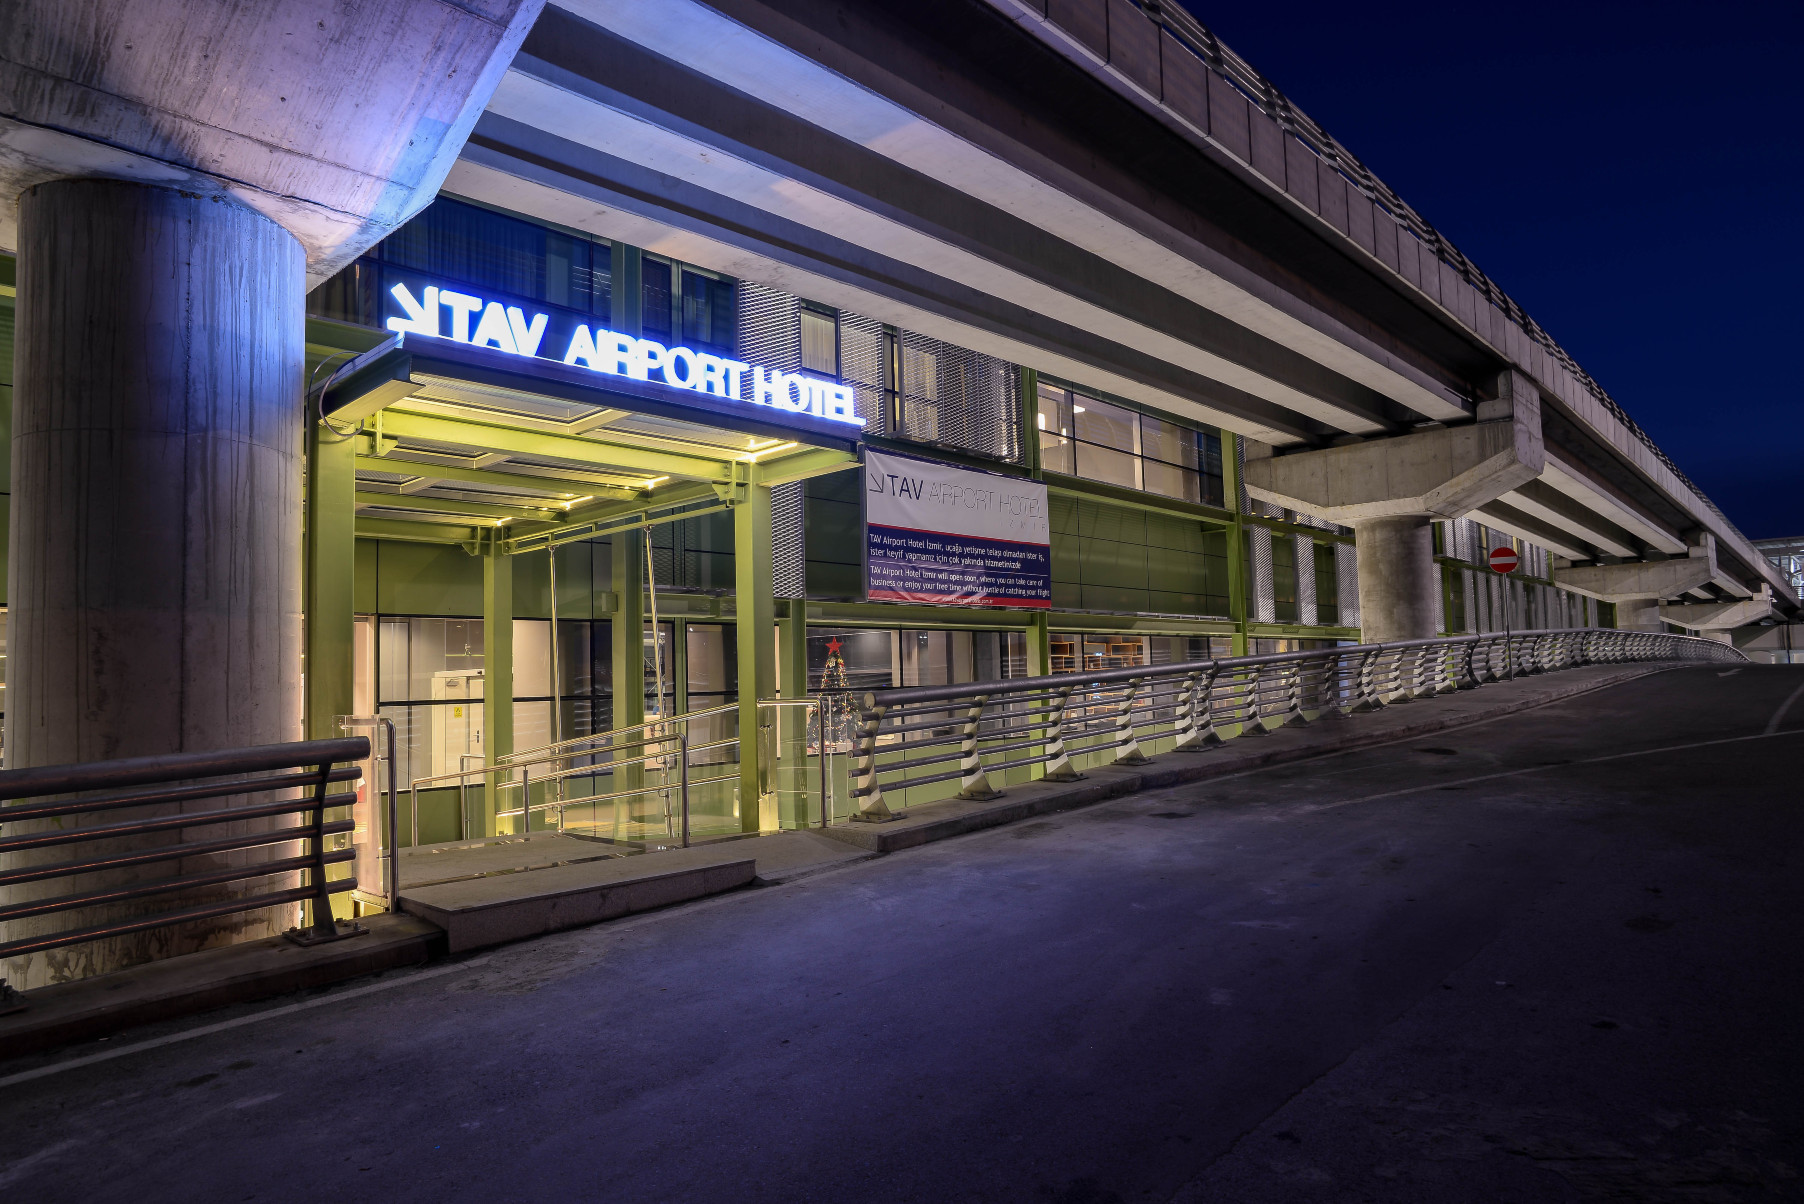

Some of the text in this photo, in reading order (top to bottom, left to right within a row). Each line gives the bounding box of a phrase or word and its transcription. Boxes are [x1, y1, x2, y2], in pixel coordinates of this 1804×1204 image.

[439, 289, 866, 426] TAV AIRPORT HOTEL
[887, 474, 1044, 519] TAV AIRPORT HOTEL
[870, 533, 882, 543] TAV
[883, 536, 906, 547] Airport
[907, 538, 925, 549] Hotel
[945, 543, 962, 554] uçağa
[963, 545, 986, 556] yetişme
[986, 547, 1002, 558] telaşı
[1002, 549, 1026, 559] olmadan
[870, 547, 885, 556] ister
[886, 548, 904, 560] keyif
[936, 553, 948, 564] için
[948, 556, 960, 565] çok
[961, 557, 984, 566] yakında
[985, 559, 1021, 569] hizmetinizde
[870, 565, 882, 574] TAV
[883, 567, 904, 577] Airport
[904, 568, 921, 578] Hotel
[937, 571, 948, 580] will
[949, 574, 963, 582] open
[964, 575, 979, 583] soon,
[979, 575, 996, 584] where
[1015, 578, 1026, 586] take
[870, 577, 896, 587] business
[904, 580, 921, 590] enjoy
[936, 582, 948, 591] free
[949, 583, 962, 592] time
[962, 584, 982, 593] without
[1005, 588, 1027, 597] catching
[1037, 589, 1050, 598] flight
